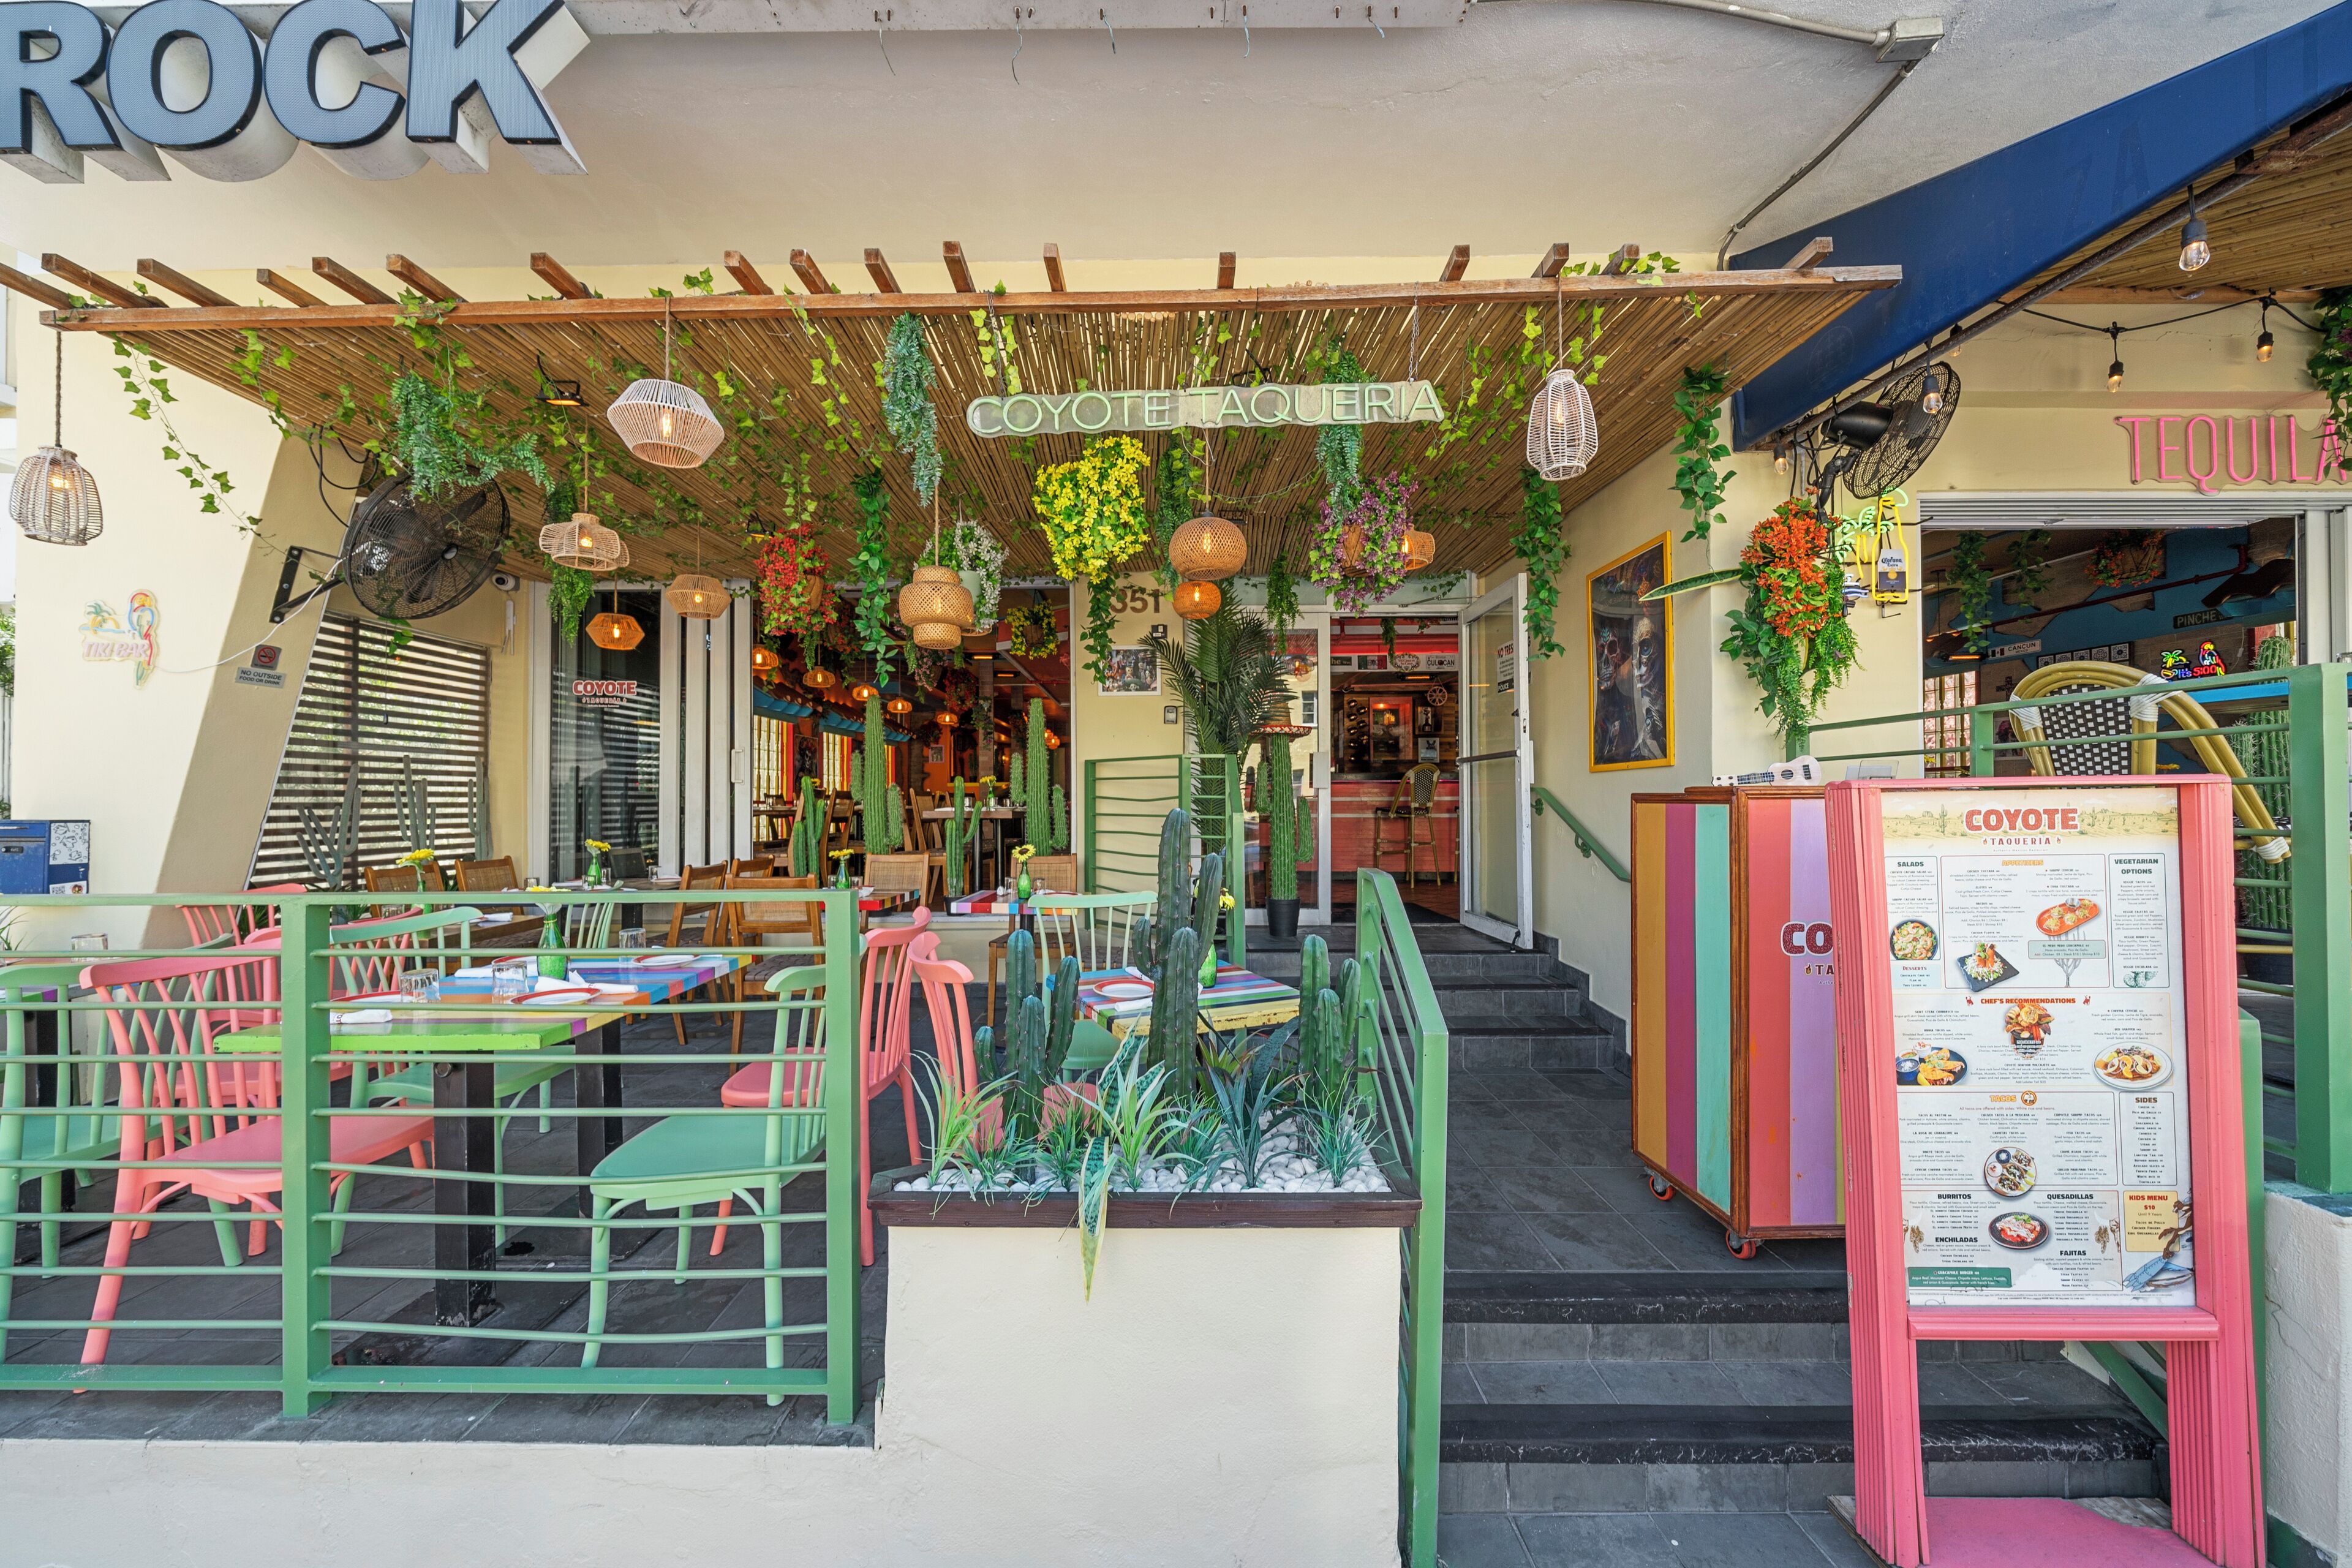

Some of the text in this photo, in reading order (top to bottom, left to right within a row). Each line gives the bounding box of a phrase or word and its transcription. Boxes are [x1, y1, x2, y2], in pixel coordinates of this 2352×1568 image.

[0, 0, 566, 150] ROCK
[968, 381, 1443, 434] COYOTE TAQUERIA
[2118, 416, 2347, 492] TEQUILA
[1110, 589, 1160, 614] 351
[2177, 610, 2217, 627] PINCHE
[84, 642, 149, 658] TIKI BAR
[1498, 647, 1504, 659] NO
[2008, 642, 2036, 652] CANCUN
[253, 671, 282, 680] OUTSIDE
[2178, 665, 2217, 678] It's 5:00
[573, 680, 637, 695] COYOTE
[1498, 682, 1509, 692] POLICE
[1966, 809, 2078, 831] COYOTE
